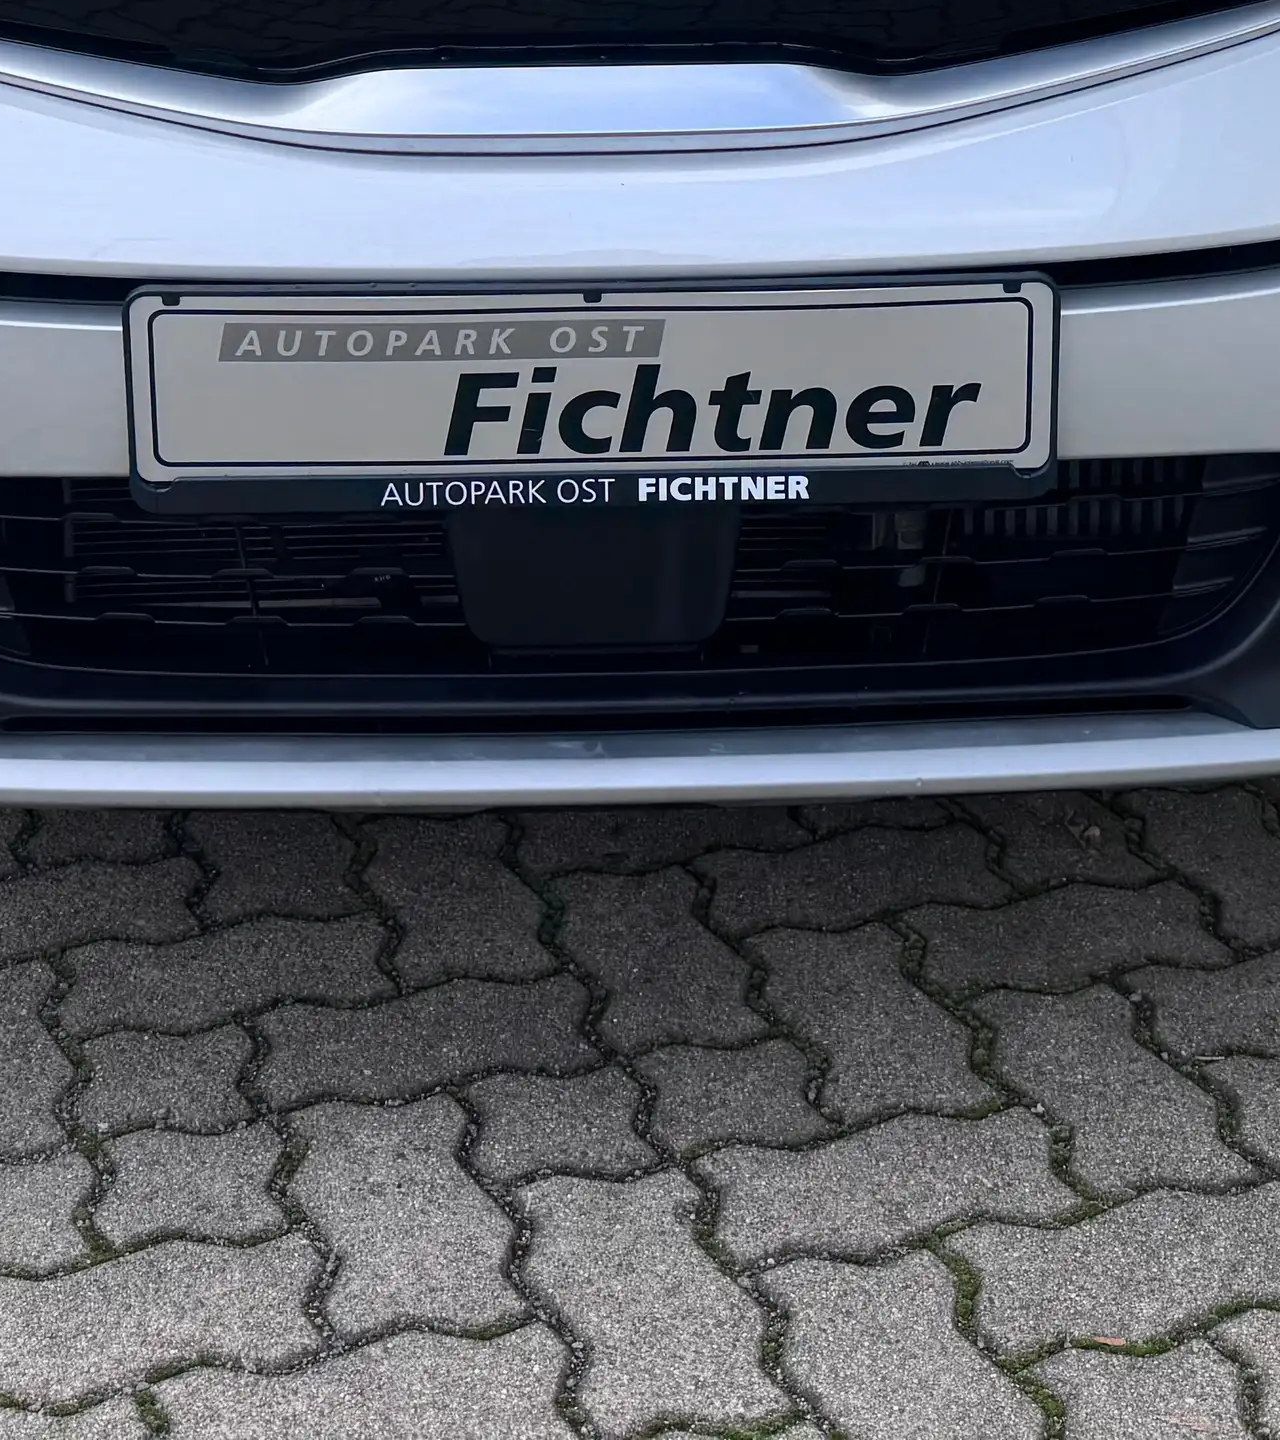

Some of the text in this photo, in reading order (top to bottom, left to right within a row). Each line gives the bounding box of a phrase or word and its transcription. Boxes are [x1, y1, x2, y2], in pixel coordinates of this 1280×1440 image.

[235, 326, 645, 357] AUTOPARK OST
[444, 364, 982, 456] Fichtner
[381, 475, 809, 507] AUTOPARK OST FICHTNER
